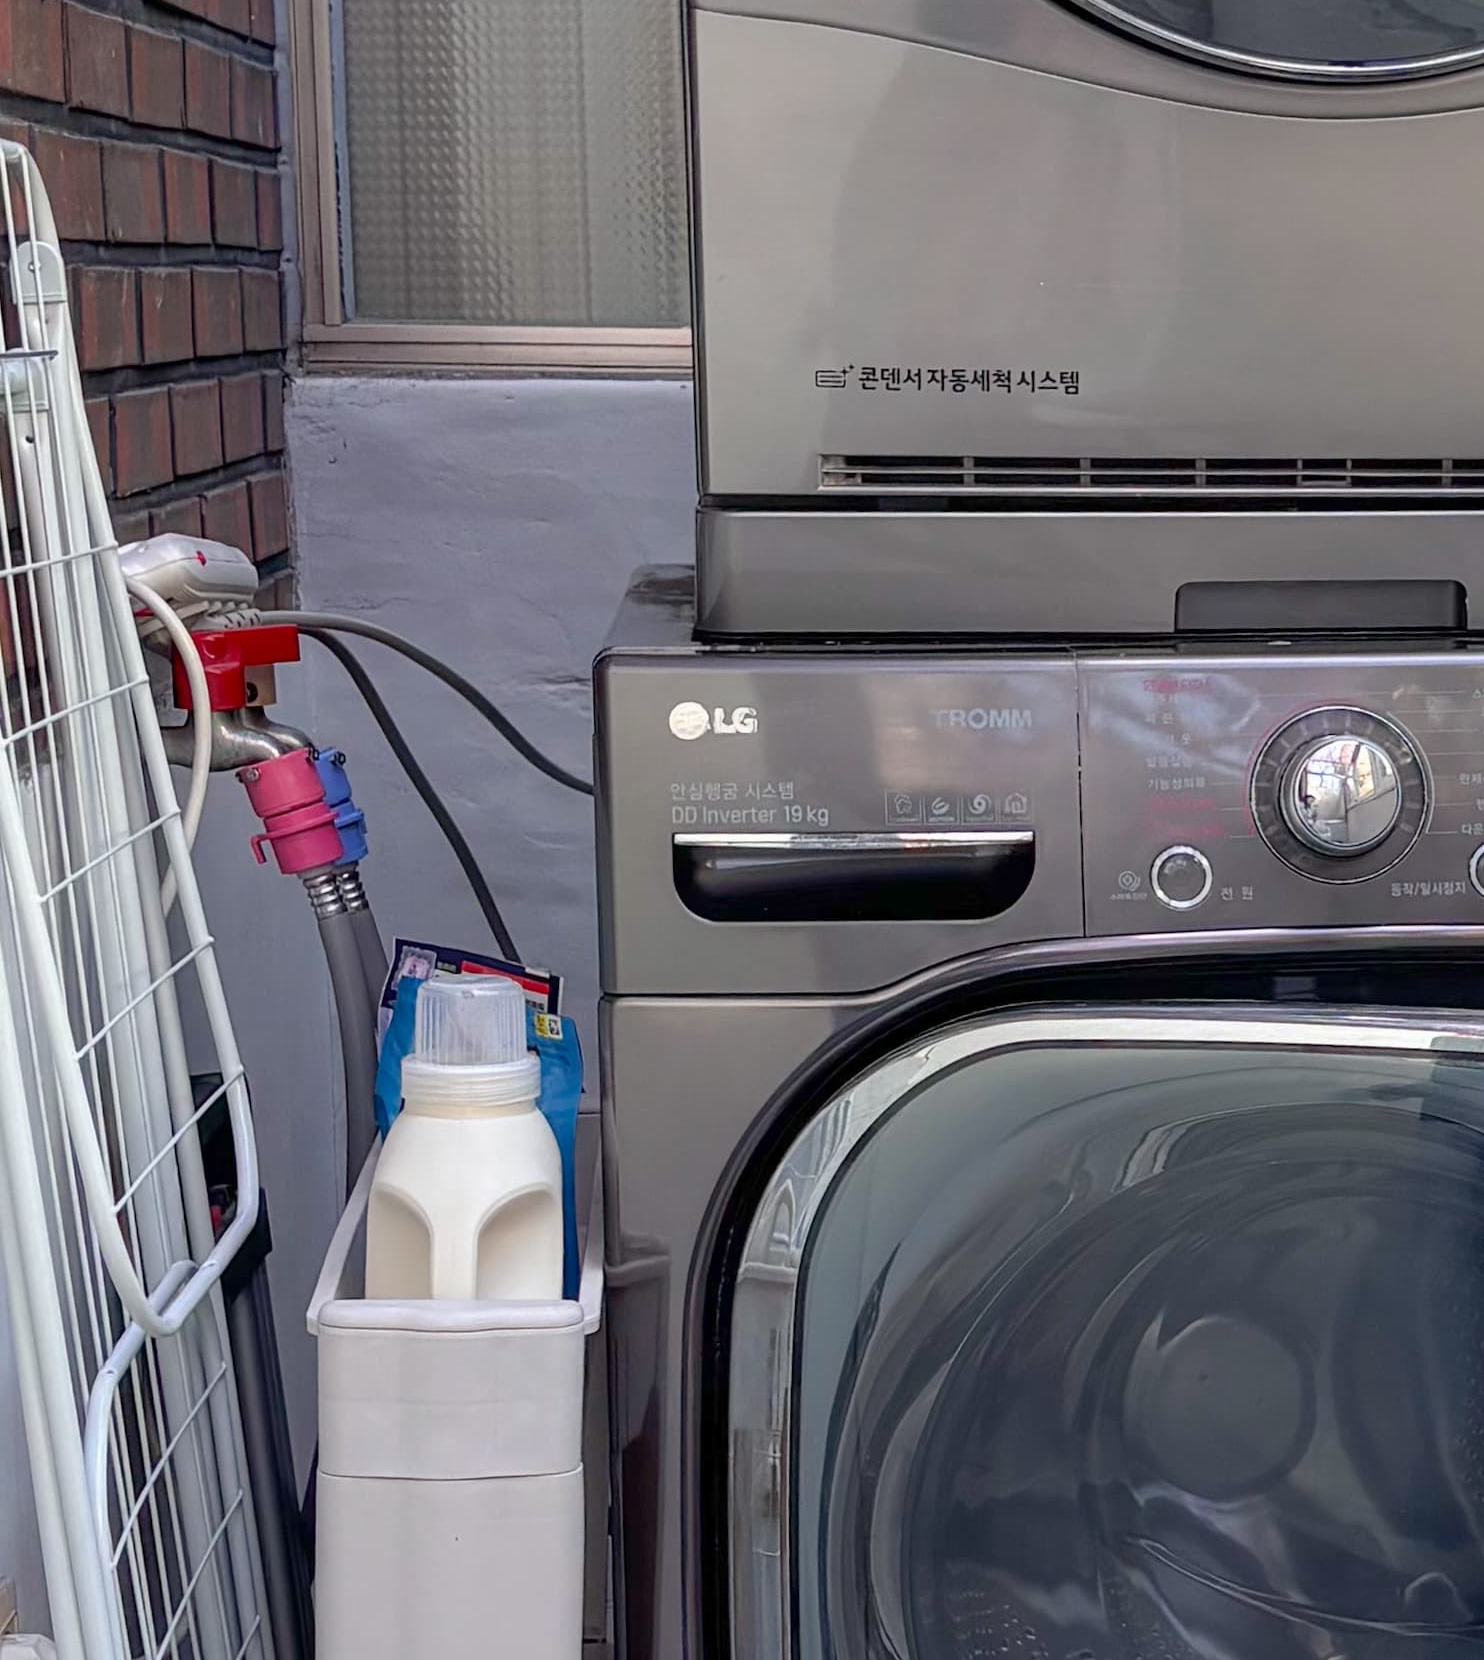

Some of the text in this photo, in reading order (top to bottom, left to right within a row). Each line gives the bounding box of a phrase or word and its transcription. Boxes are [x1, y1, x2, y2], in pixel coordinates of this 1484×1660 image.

[858, 366, 1080, 395] 콘덴서 자동세척 시스템
[712, 707, 759, 734] LG
[931, 708, 1032, 729] TROMM
[745, 781, 794, 800] 시스템
[672, 806, 697, 824] DD
[703, 806, 777, 824] Inverter
